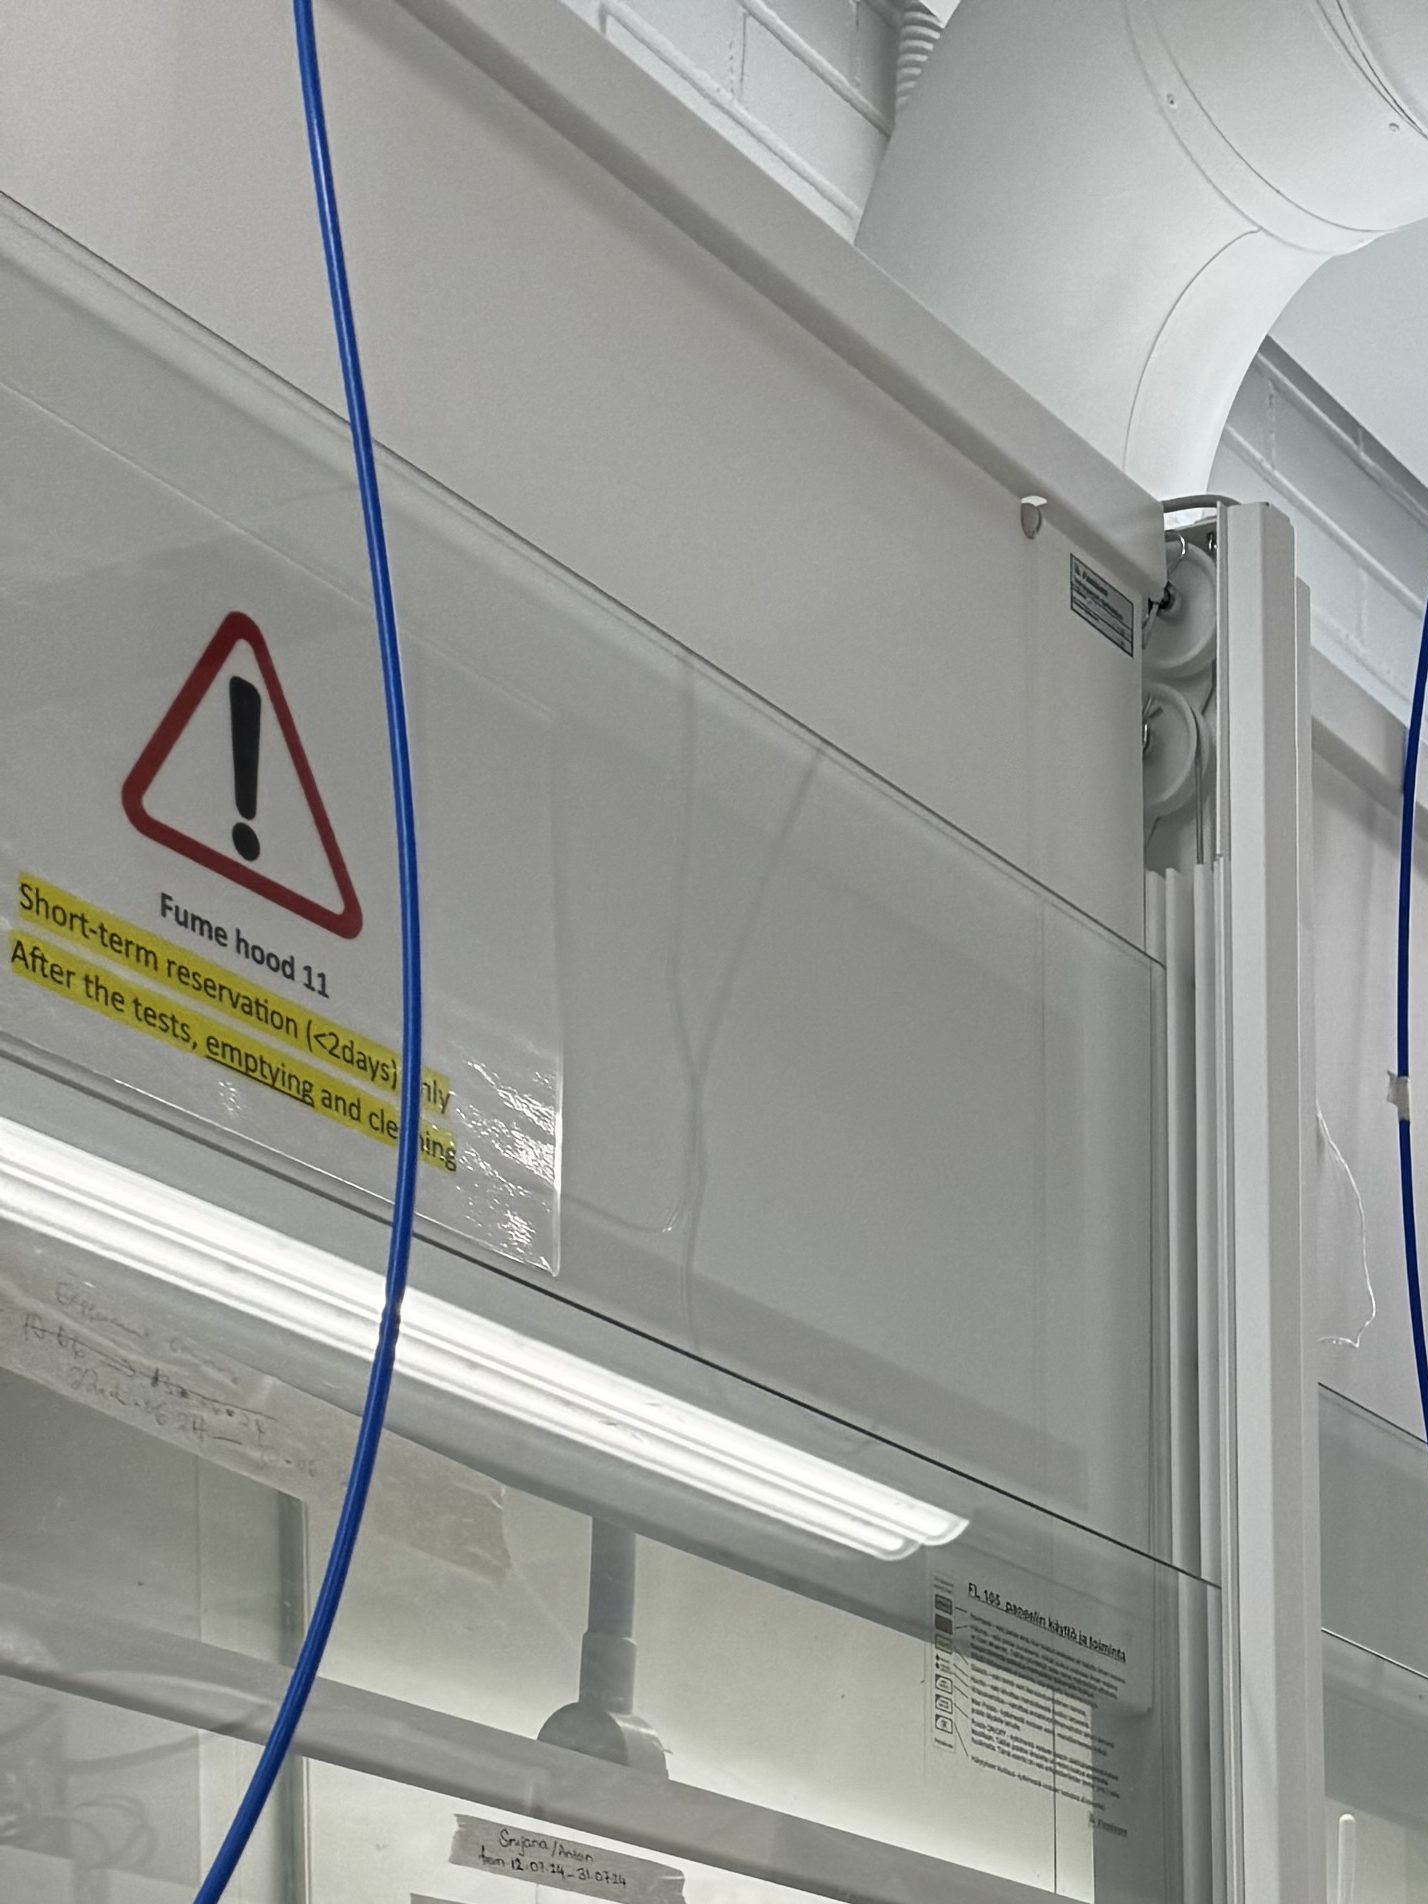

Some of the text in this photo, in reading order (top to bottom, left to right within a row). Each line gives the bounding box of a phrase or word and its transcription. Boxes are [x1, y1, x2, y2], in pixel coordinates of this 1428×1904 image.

[19, 882, 158, 972] Short-term
[166, 956, 298, 1039] reservation
[306, 1019, 398, 1091] (<2days)
[160, 892, 330, 999] Fume hood 11
[11, 940, 457, 1172] After the tests, emptying and cleing
